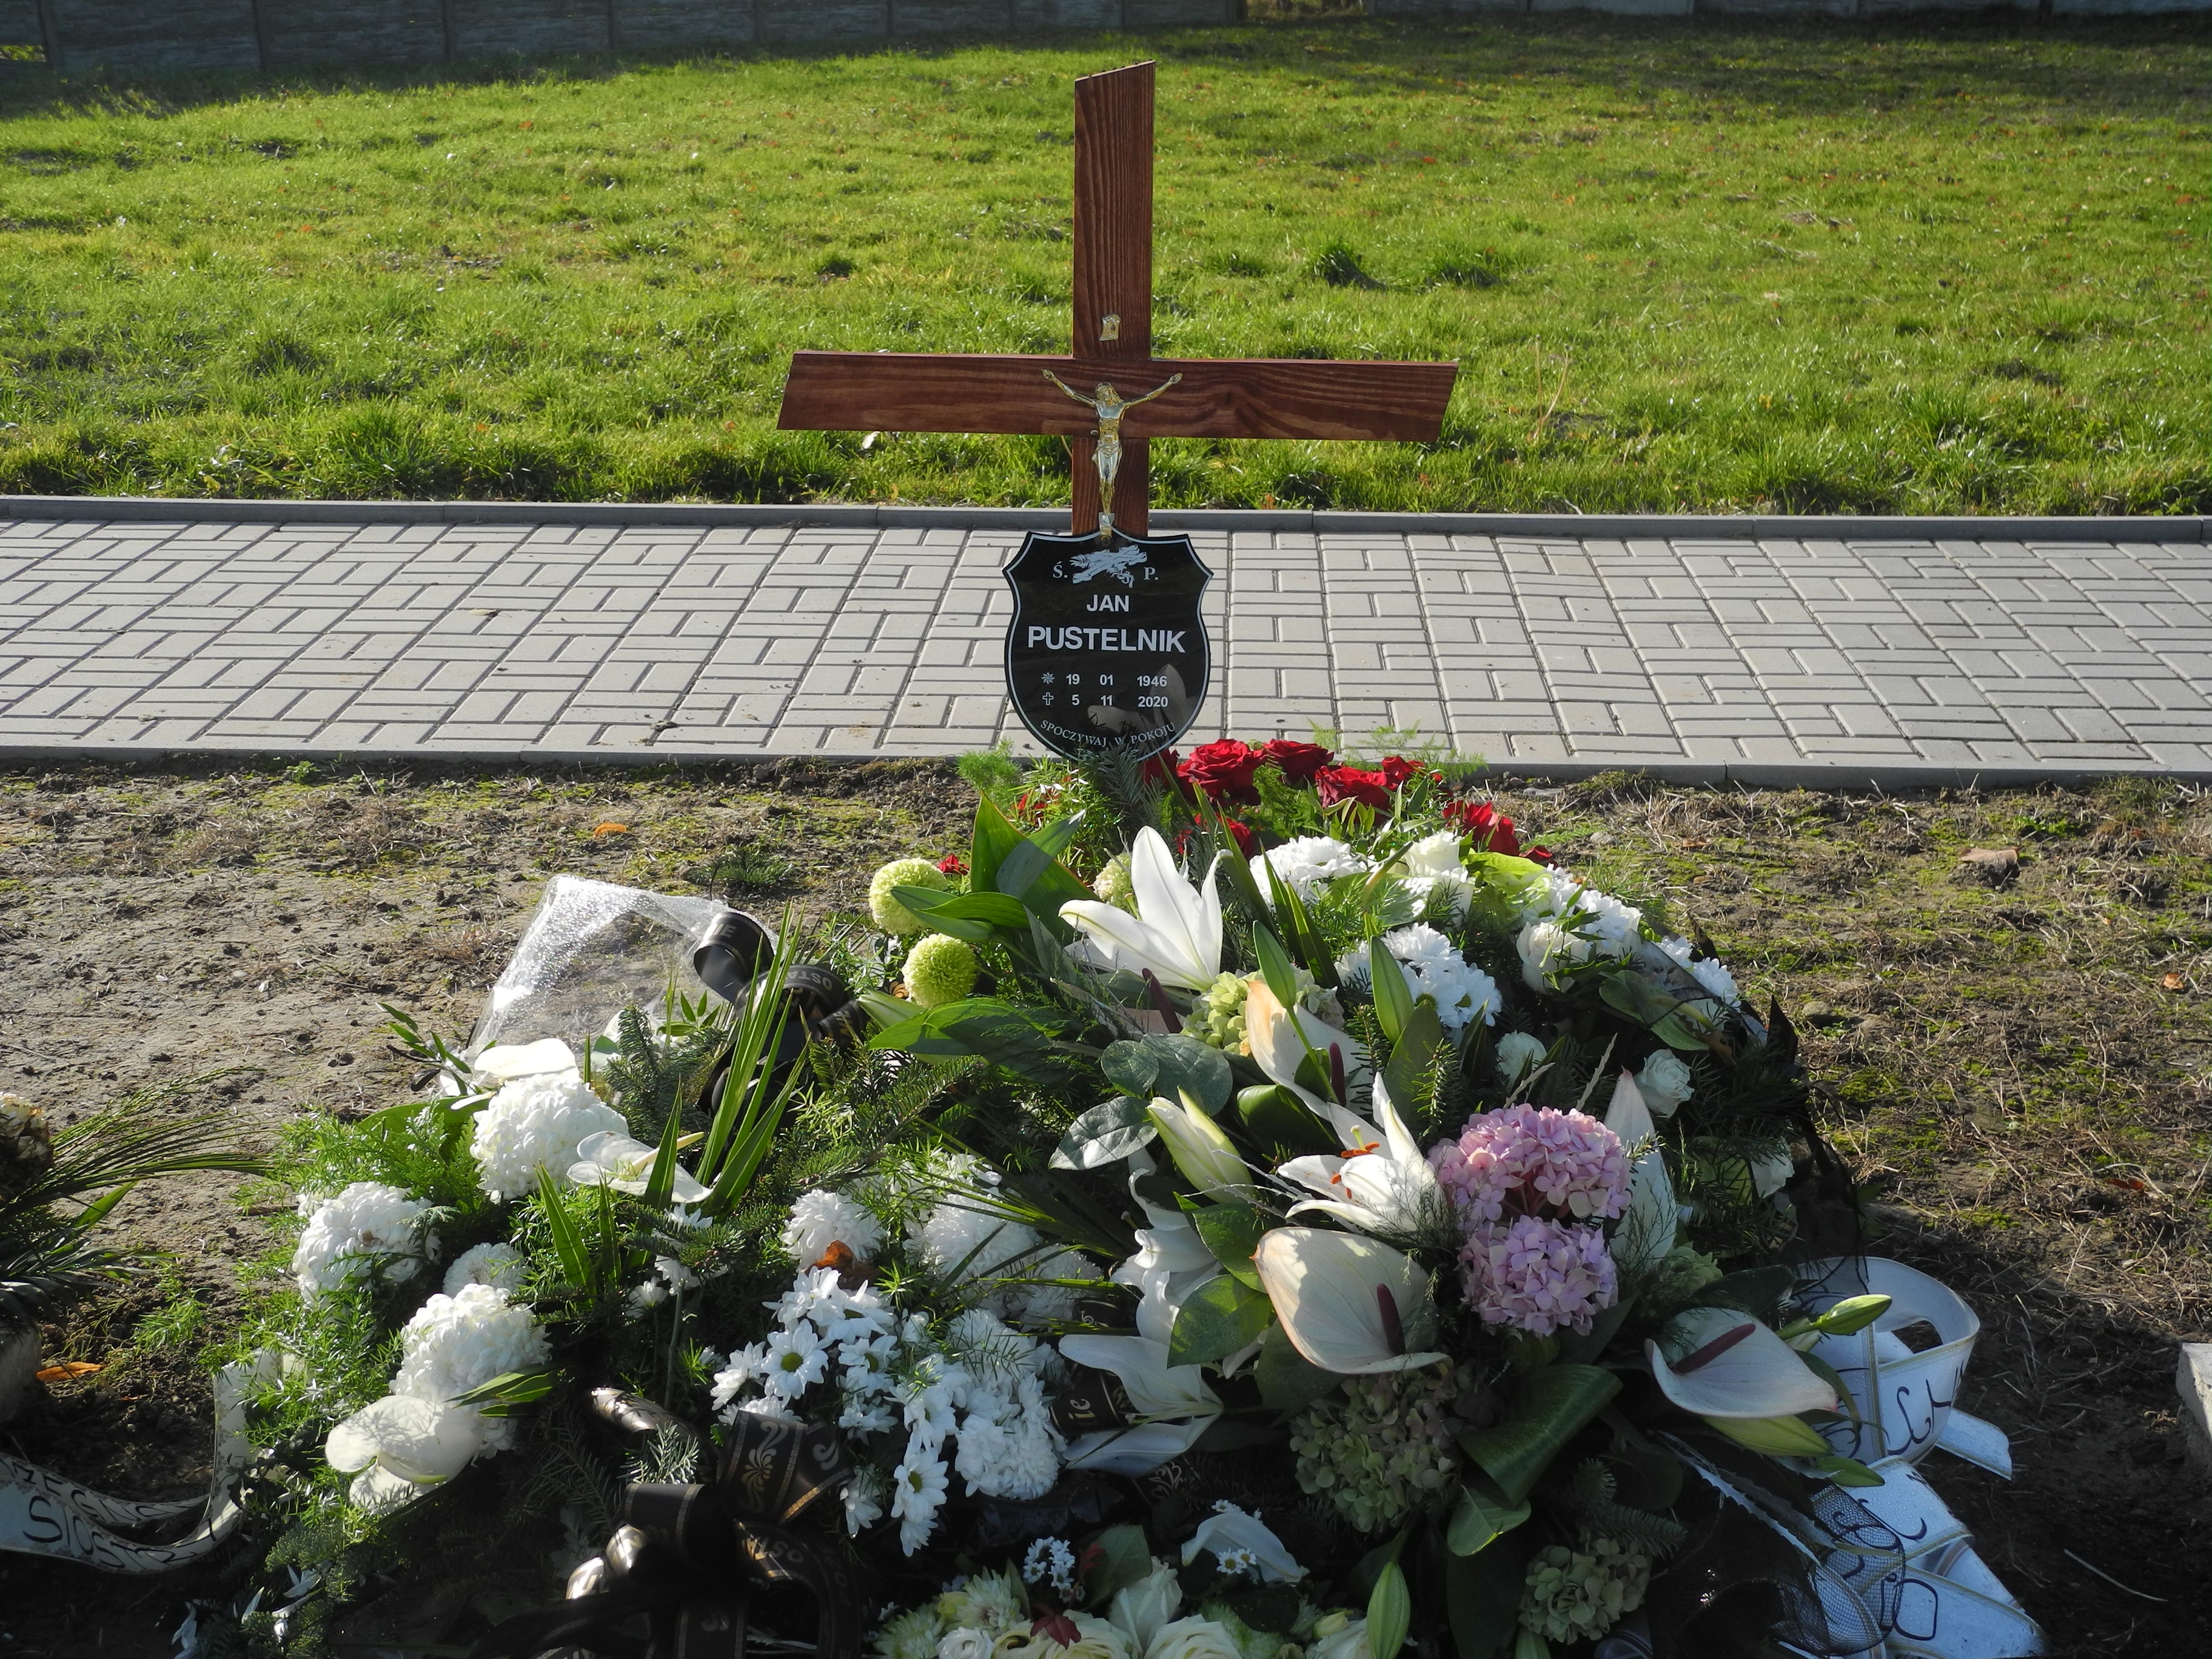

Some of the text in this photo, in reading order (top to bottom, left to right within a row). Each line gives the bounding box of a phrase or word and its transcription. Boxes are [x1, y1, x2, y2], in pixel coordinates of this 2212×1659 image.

[1053, 561, 1159, 580] Ś. P.
[1086, 594, 1130, 612] JAN
[1028, 626, 1186, 653] PUSTELNIK
[1066, 674, 1168, 687] 19 01 1946
[1071, 694, 1168, 708] 5 11 2020
[1040, 720, 1176, 747] SPOCZYWAJ W POKOJU
